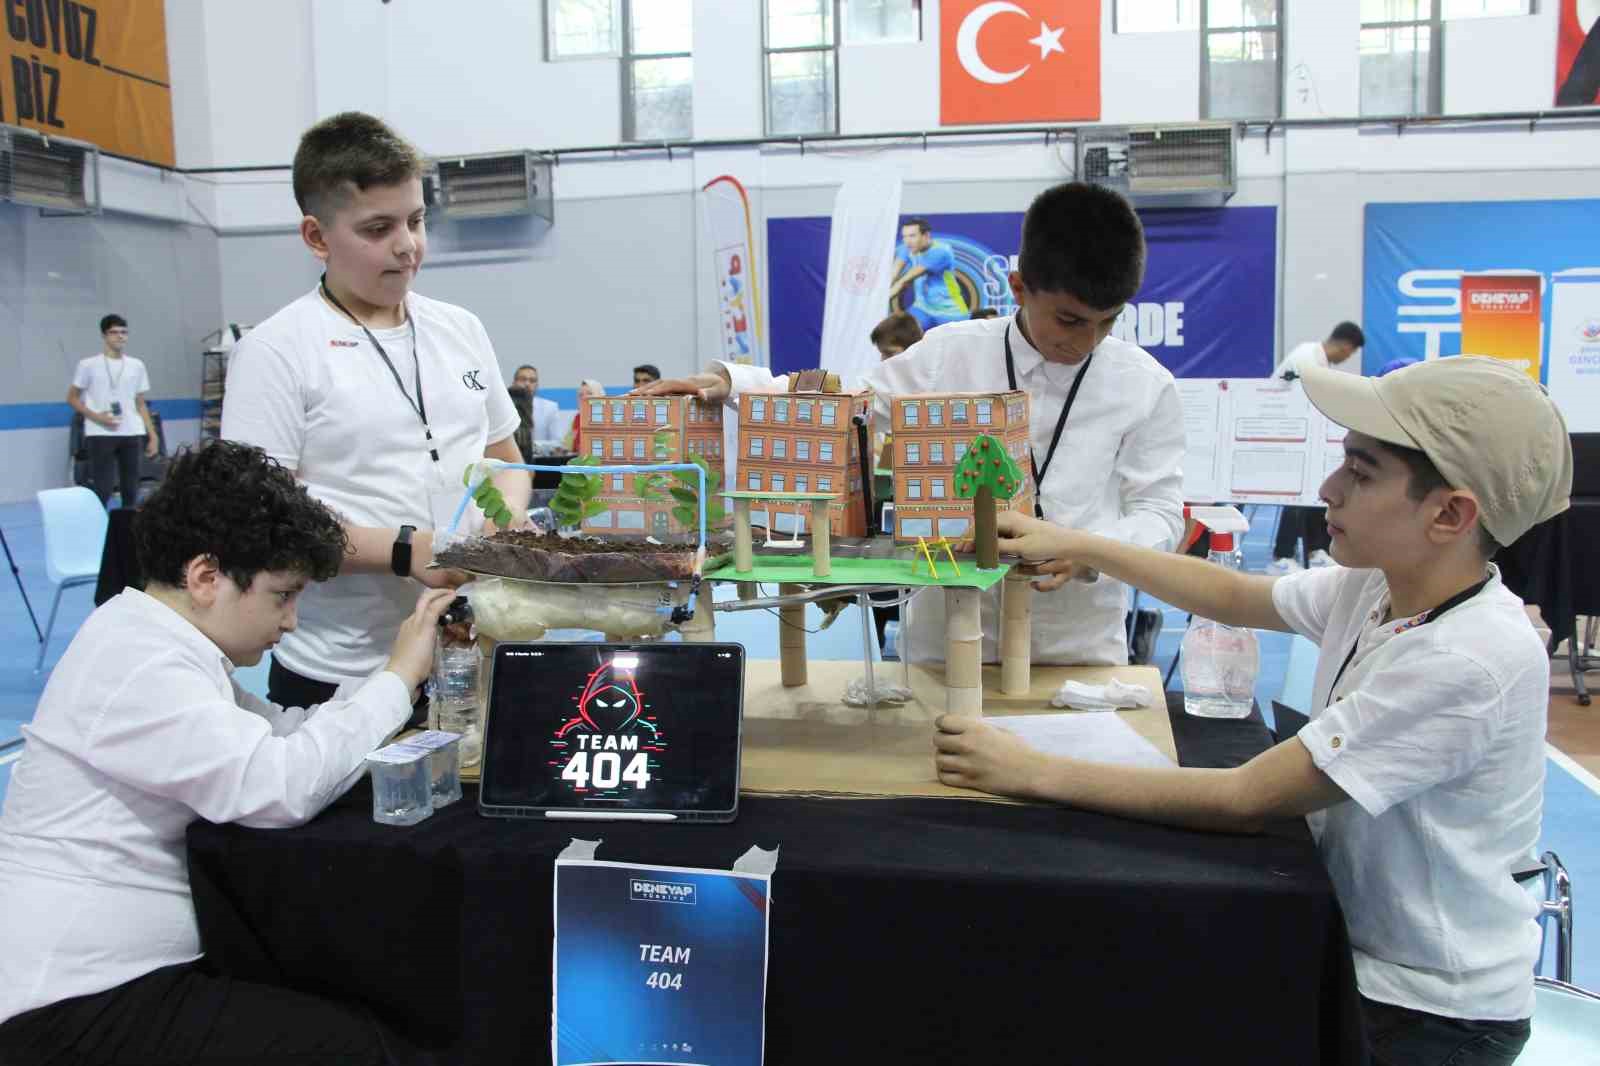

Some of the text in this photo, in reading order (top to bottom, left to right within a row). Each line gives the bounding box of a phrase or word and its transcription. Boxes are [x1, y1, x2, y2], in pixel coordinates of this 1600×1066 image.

[1108, 302, 1185, 347] RDE
[576, 734, 639, 751] TEAM
[561, 751, 651, 790] 404
[632, 882, 693, 896] DENEYAP
[639, 944, 692, 965] TEAM
[646, 971, 683, 990] 404
